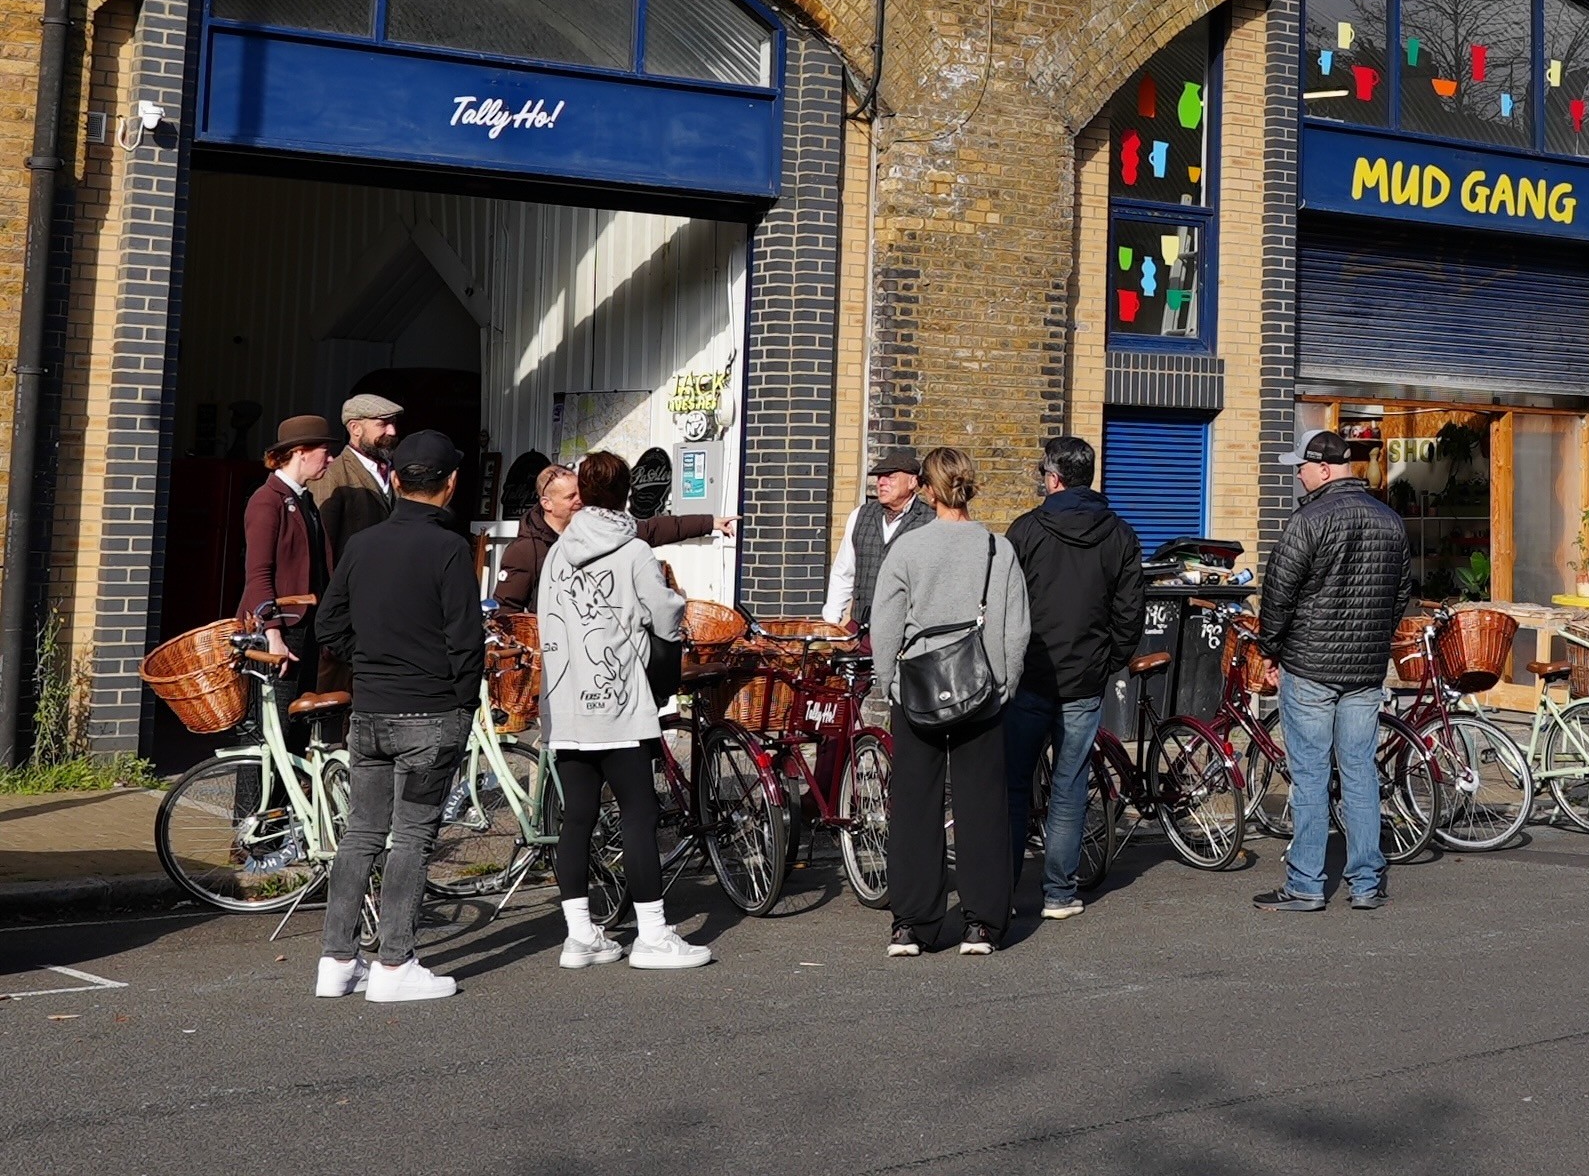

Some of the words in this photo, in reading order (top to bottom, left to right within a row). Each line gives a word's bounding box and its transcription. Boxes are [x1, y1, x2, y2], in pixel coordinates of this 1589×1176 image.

[450, 95, 512, 139] Tally
[513, 98, 565, 128] Ho!
[1351, 156, 1451, 209] MUD
[1460, 170, 1577, 224] GANG
[443, 787, 466, 821] TALLY
